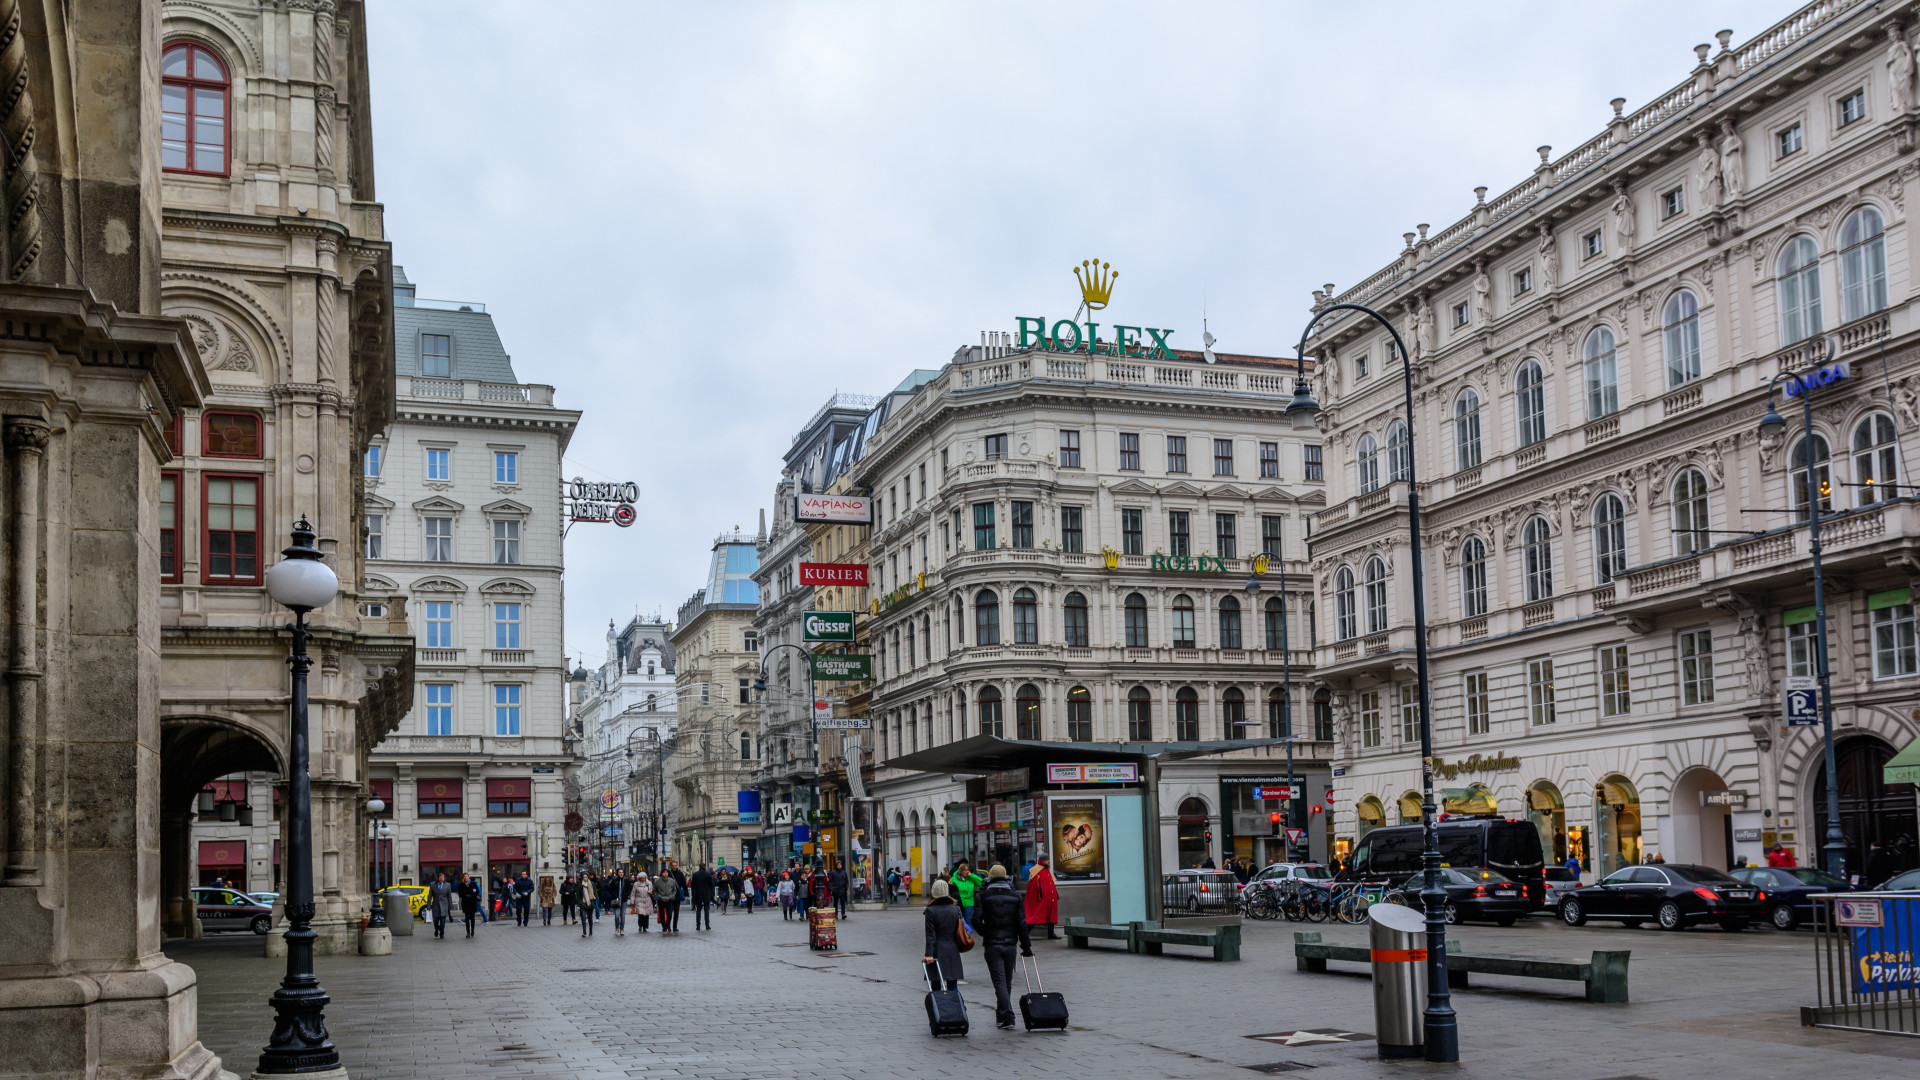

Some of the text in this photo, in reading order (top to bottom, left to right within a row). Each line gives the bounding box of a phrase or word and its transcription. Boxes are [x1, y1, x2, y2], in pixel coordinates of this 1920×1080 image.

[1015, 316, 1178, 359] ROLEX
[1786, 364, 1844, 396] UNIQA
[571, 502, 611, 519] WIEN
[1151, 554, 1228, 573] ROLEX
[805, 568, 863, 580] KURIER
[806, 615, 851, 637] Gösser
[816, 661, 861, 669] GASTHAUS
[1793, 696, 1807, 715] P
